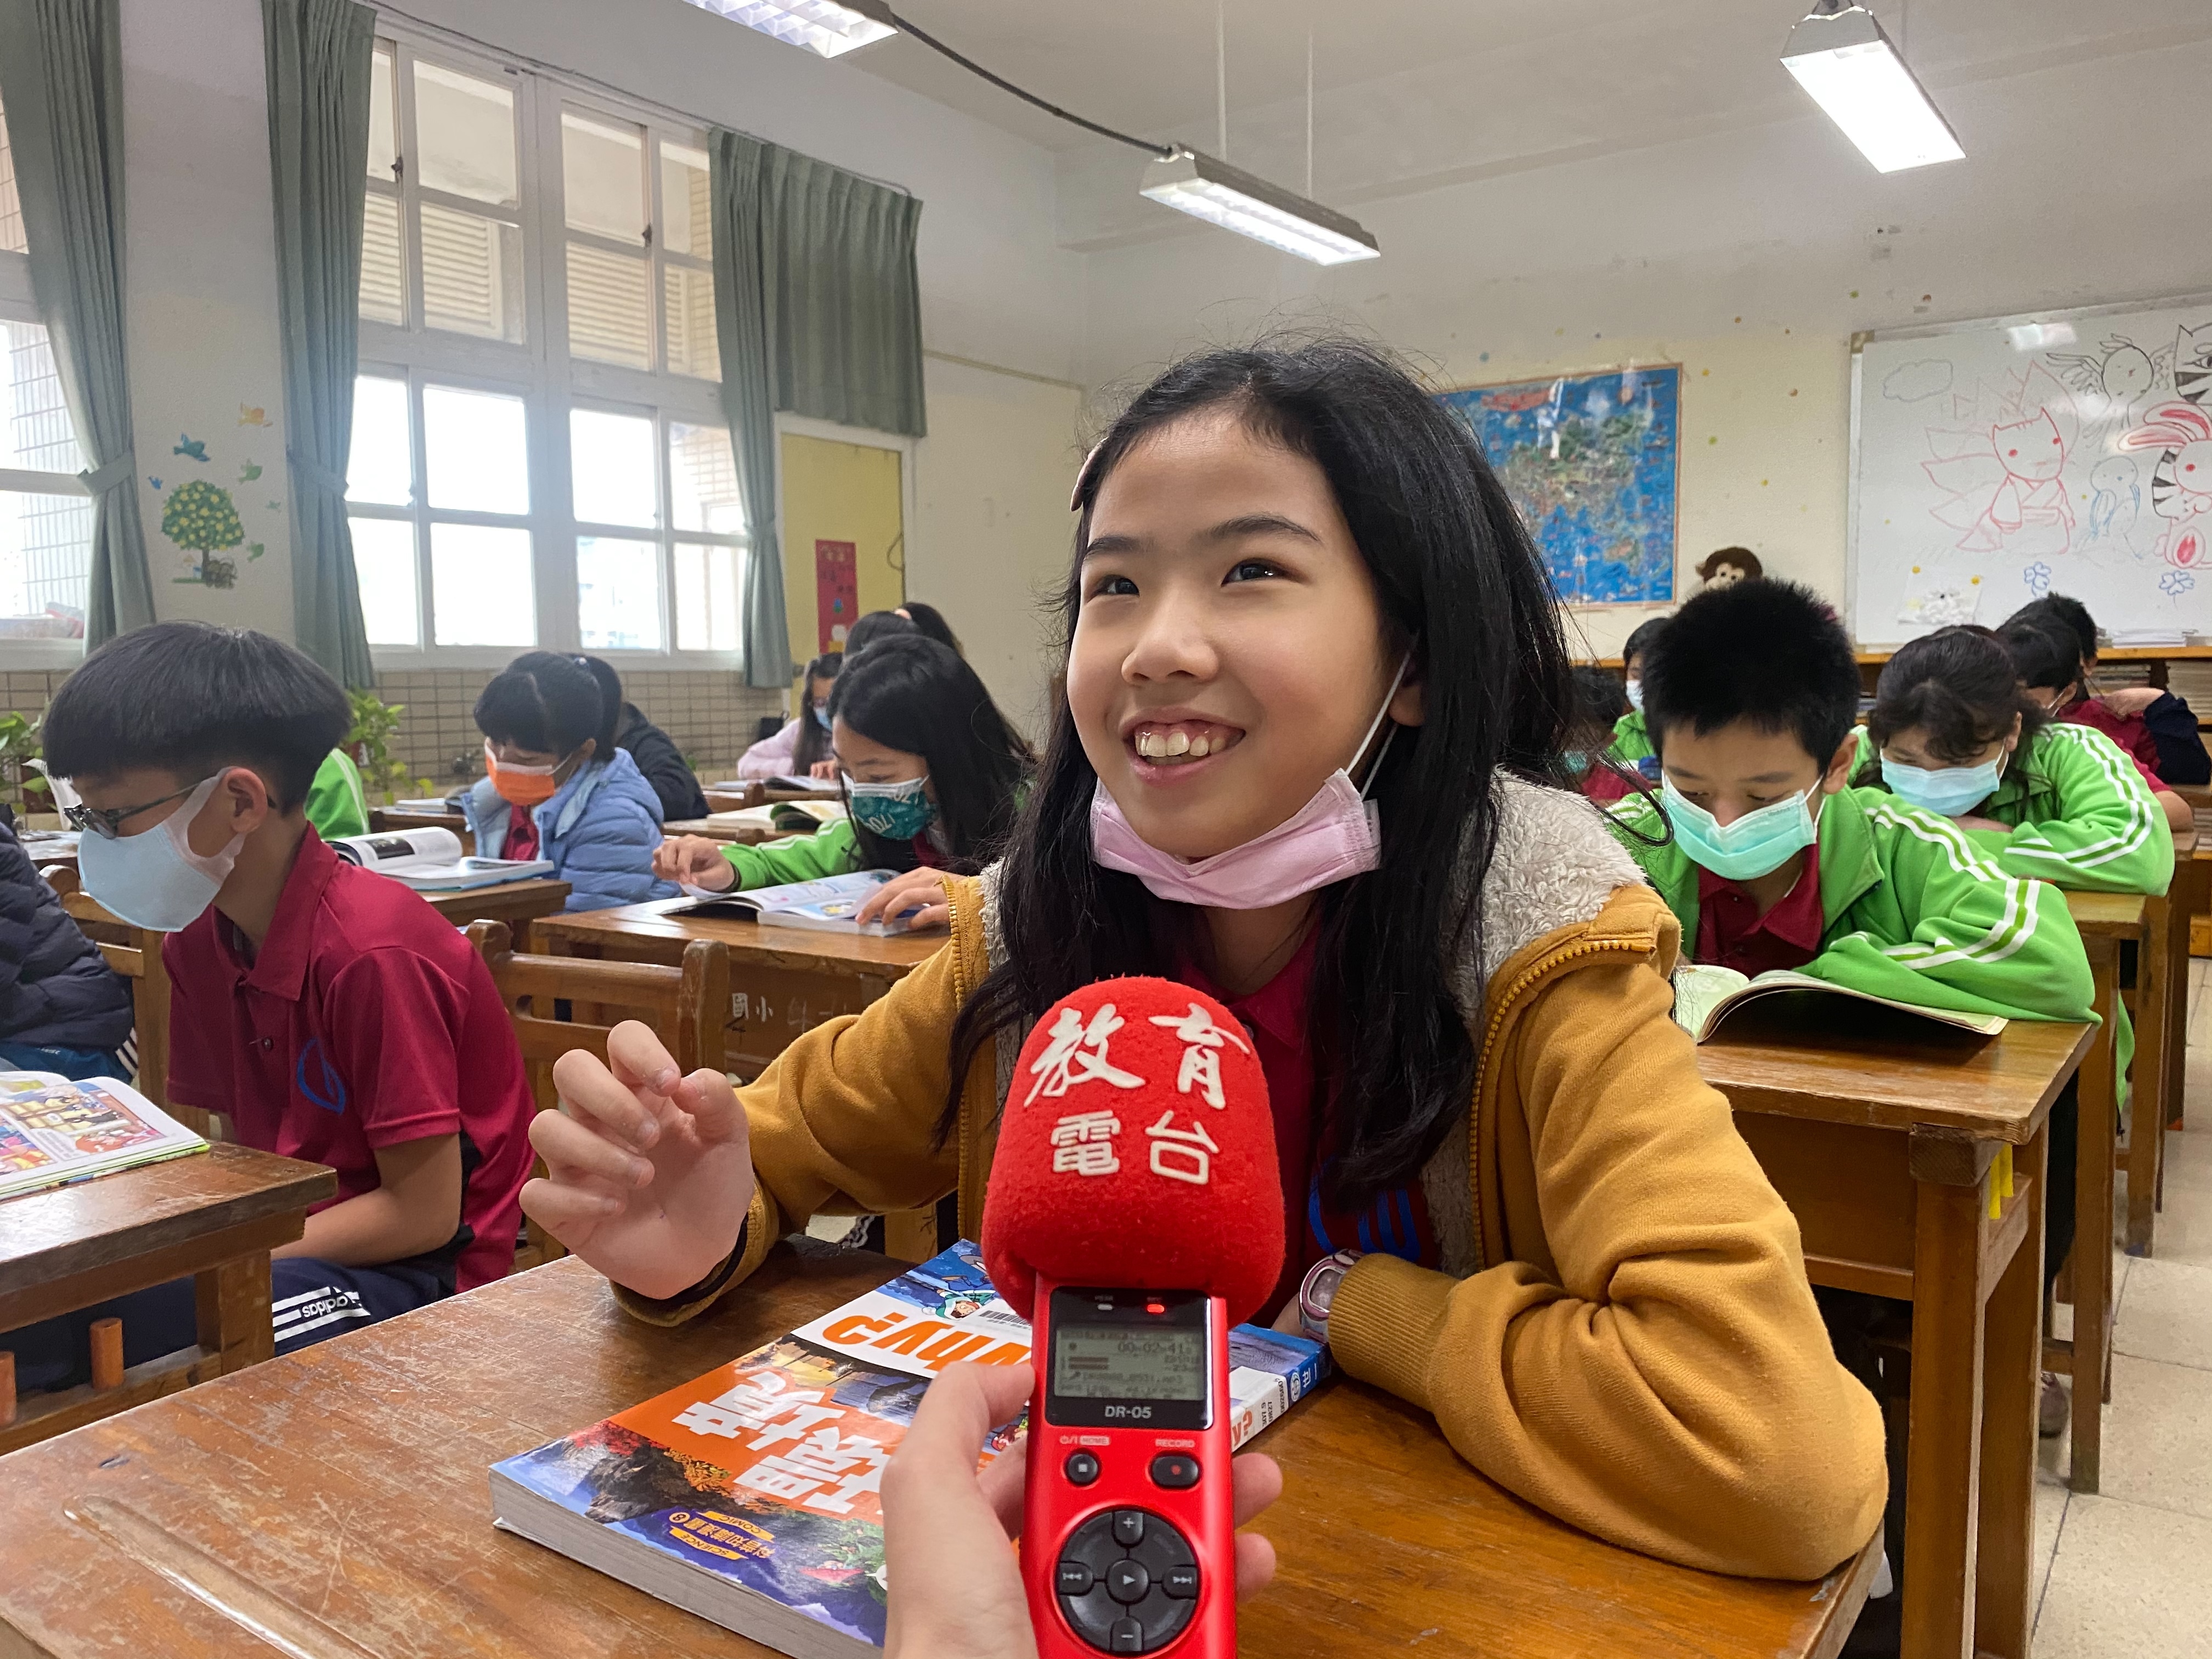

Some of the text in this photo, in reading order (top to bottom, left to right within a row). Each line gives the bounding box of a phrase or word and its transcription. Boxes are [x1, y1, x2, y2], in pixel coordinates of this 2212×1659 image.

[1024, 1002, 1251, 1110] 教育
[1051, 1110, 1219, 1184] 電台
[302, 1296, 348, 1318] adidas
[1104, 1404, 1152, 1419] DR-05
[672, 1371, 891, 1514] 環境
[719, 1515, 761, 1534] COMIC
[680, 1533, 730, 1556] SCIENCE
